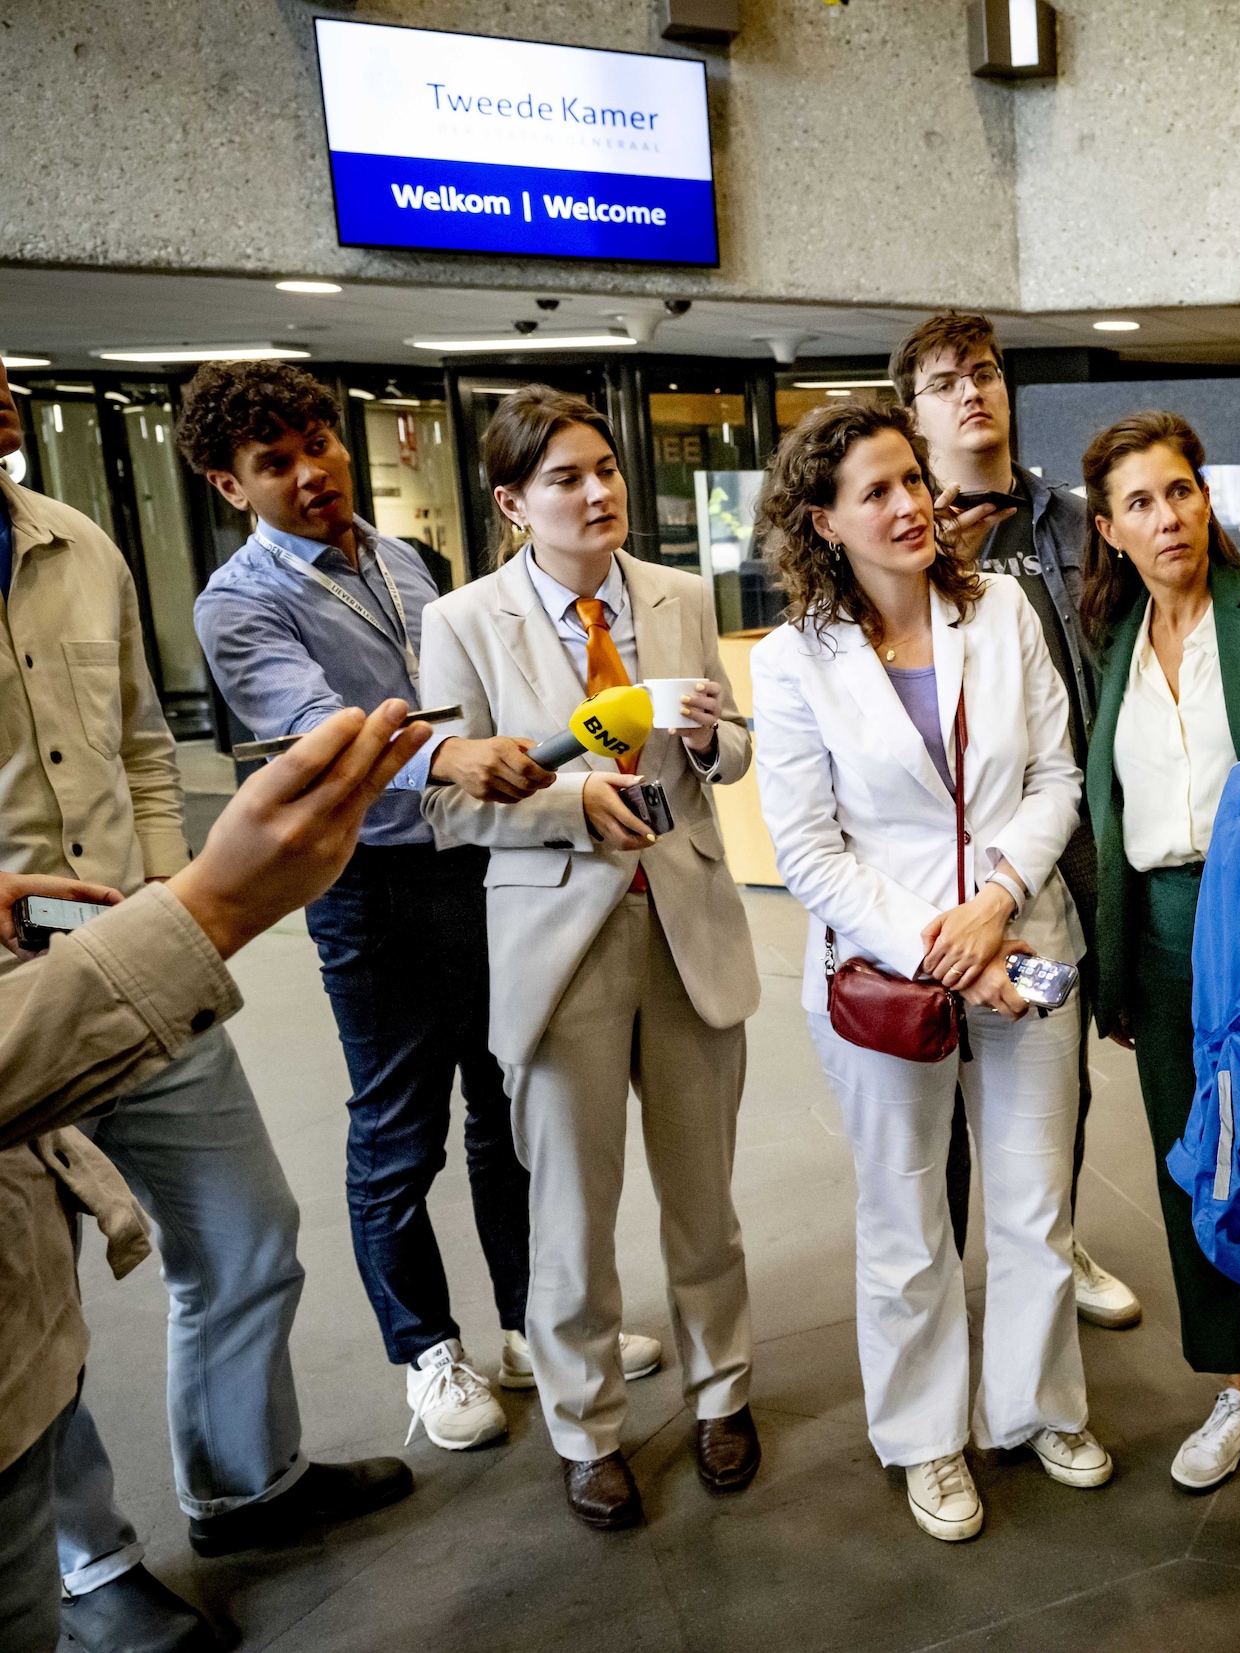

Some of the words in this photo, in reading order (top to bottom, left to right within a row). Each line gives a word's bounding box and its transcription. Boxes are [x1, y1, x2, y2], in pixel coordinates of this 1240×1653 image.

[426, 82, 553, 121] Tweede
[561, 96, 659, 131] Kamer
[390, 183, 511, 215] Welkom
[542, 194, 667, 226] Welcome
[331, 584, 355, 605] LIEVER
[353, 602, 364, 612] IN
[583, 715, 630, 755] BNR
